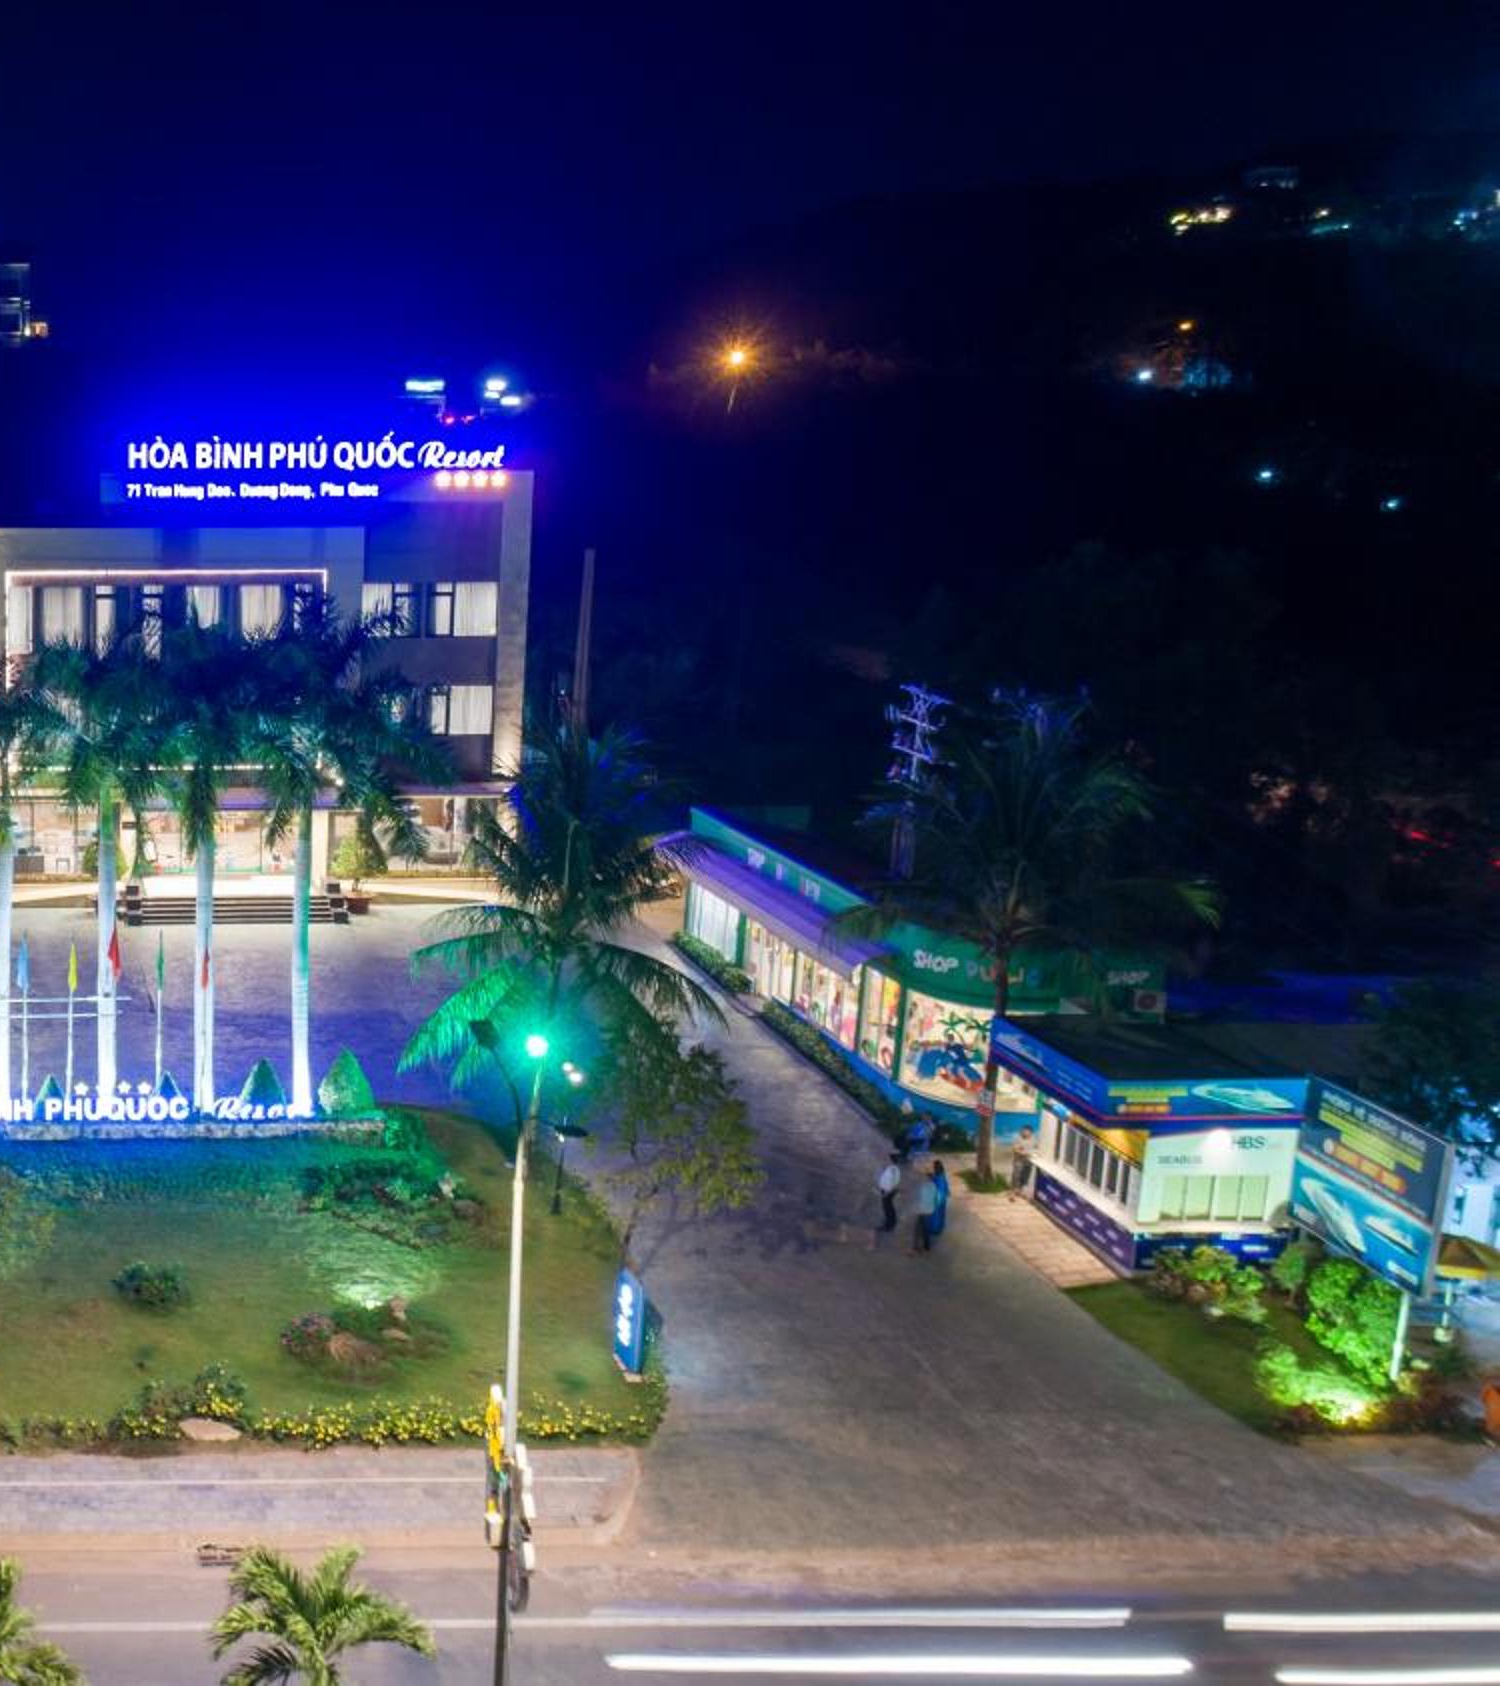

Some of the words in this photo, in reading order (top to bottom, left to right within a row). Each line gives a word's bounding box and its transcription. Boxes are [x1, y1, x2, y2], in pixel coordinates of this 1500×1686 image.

[127, 435, 188, 469] HÒA
[196, 435, 263, 469] BÌNH
[269, 435, 328, 469] PHÚ
[333, 431, 416, 471] QUỐC
[417, 440, 506, 469] Resort
[126, 483, 141, 497] 71
[912, 948, 959, 972] SHOP
[45, 1097, 101, 1121] PHU
